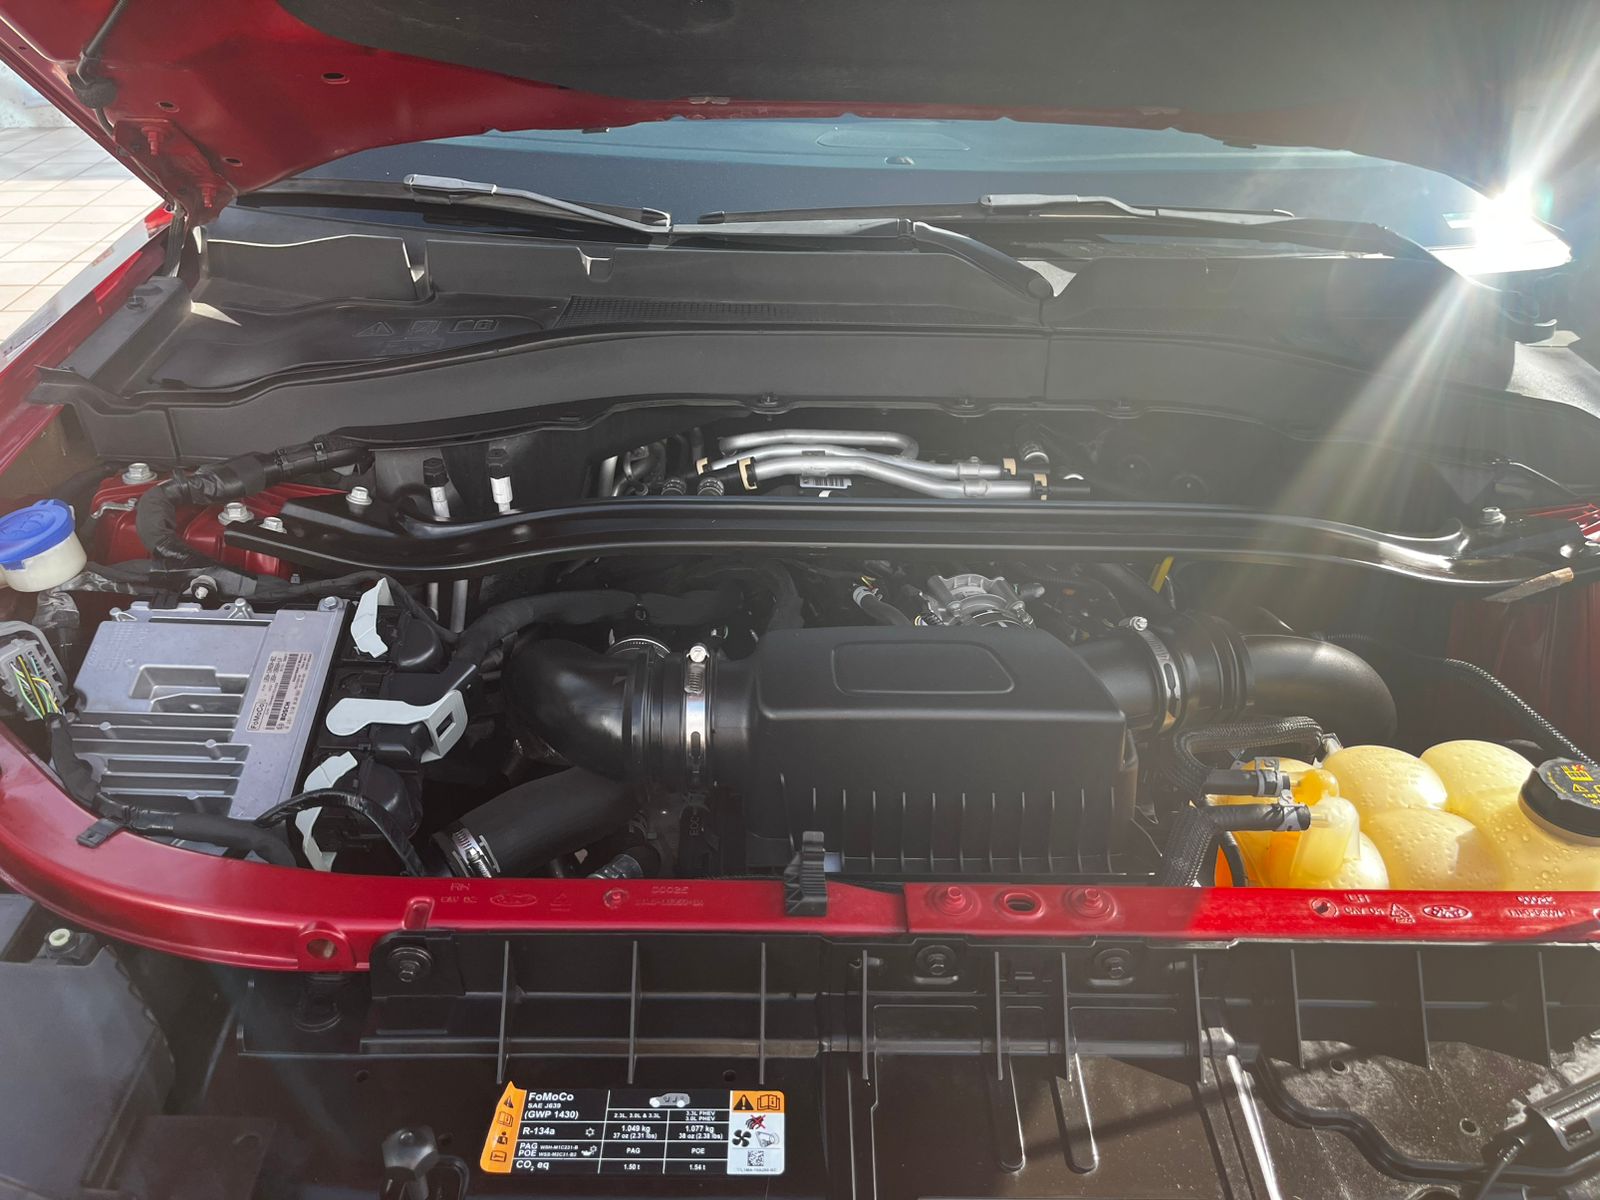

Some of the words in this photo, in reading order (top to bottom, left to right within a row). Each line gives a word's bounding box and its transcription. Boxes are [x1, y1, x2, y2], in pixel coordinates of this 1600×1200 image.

[280, 701, 291, 721] BOSCH
[528, 1092, 574, 1101] FoMoCo
[524, 1110, 552, 1119] (GWP
[554, 1110, 579, 1120] 1430)
[522, 1127, 556, 1135] R-134a
[641, 1125, 651, 1133] kg
[706, 1125, 715, 1134] kg
[645, 1132, 658, 1140] lbs)
[711, 1133, 724, 1141] lbs)
[519, 1142, 538, 1150] PAG
[518, 1149, 537, 1157] POE
[537, 1161, 550, 1170] eq
